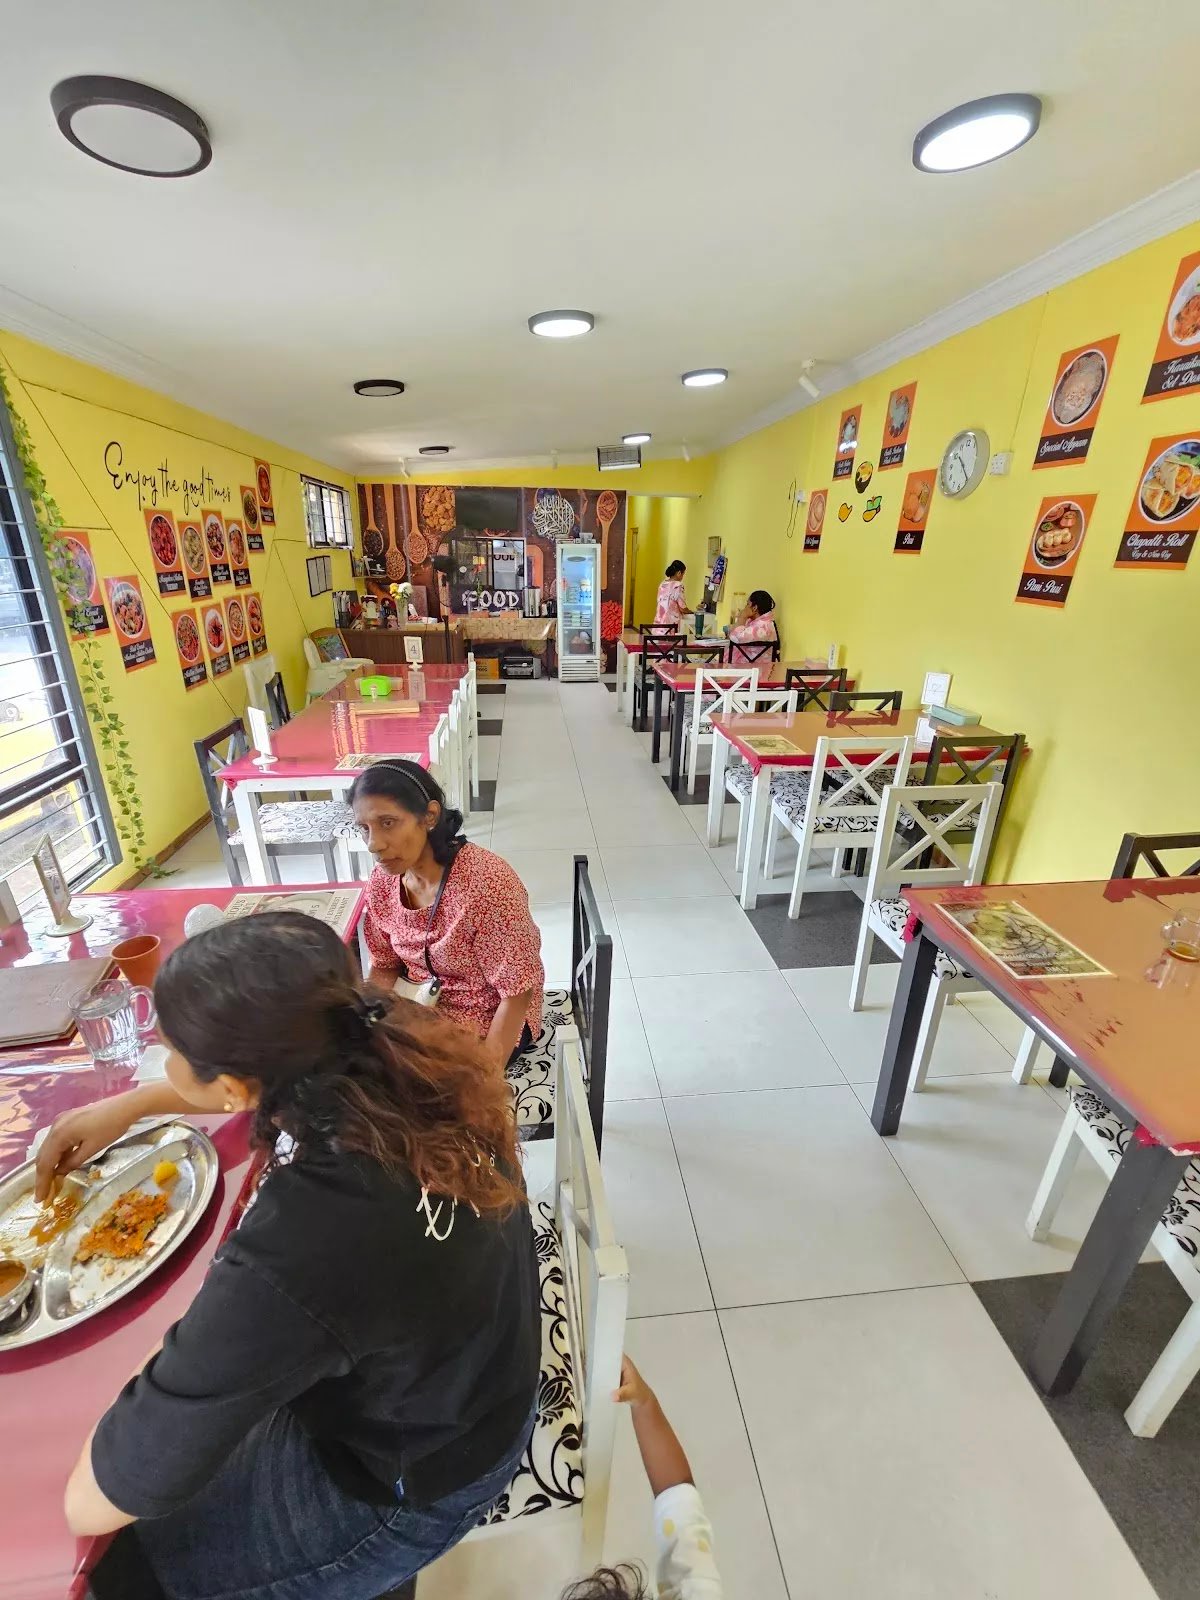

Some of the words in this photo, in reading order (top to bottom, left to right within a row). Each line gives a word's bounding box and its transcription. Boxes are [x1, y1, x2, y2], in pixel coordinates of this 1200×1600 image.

[104, 441, 159, 512] Enjoy
[157, 457, 180, 498] the
[182, 465, 206, 516] good
[204, 471, 231, 503] times
[1162, 532, 1190, 547] Roll
